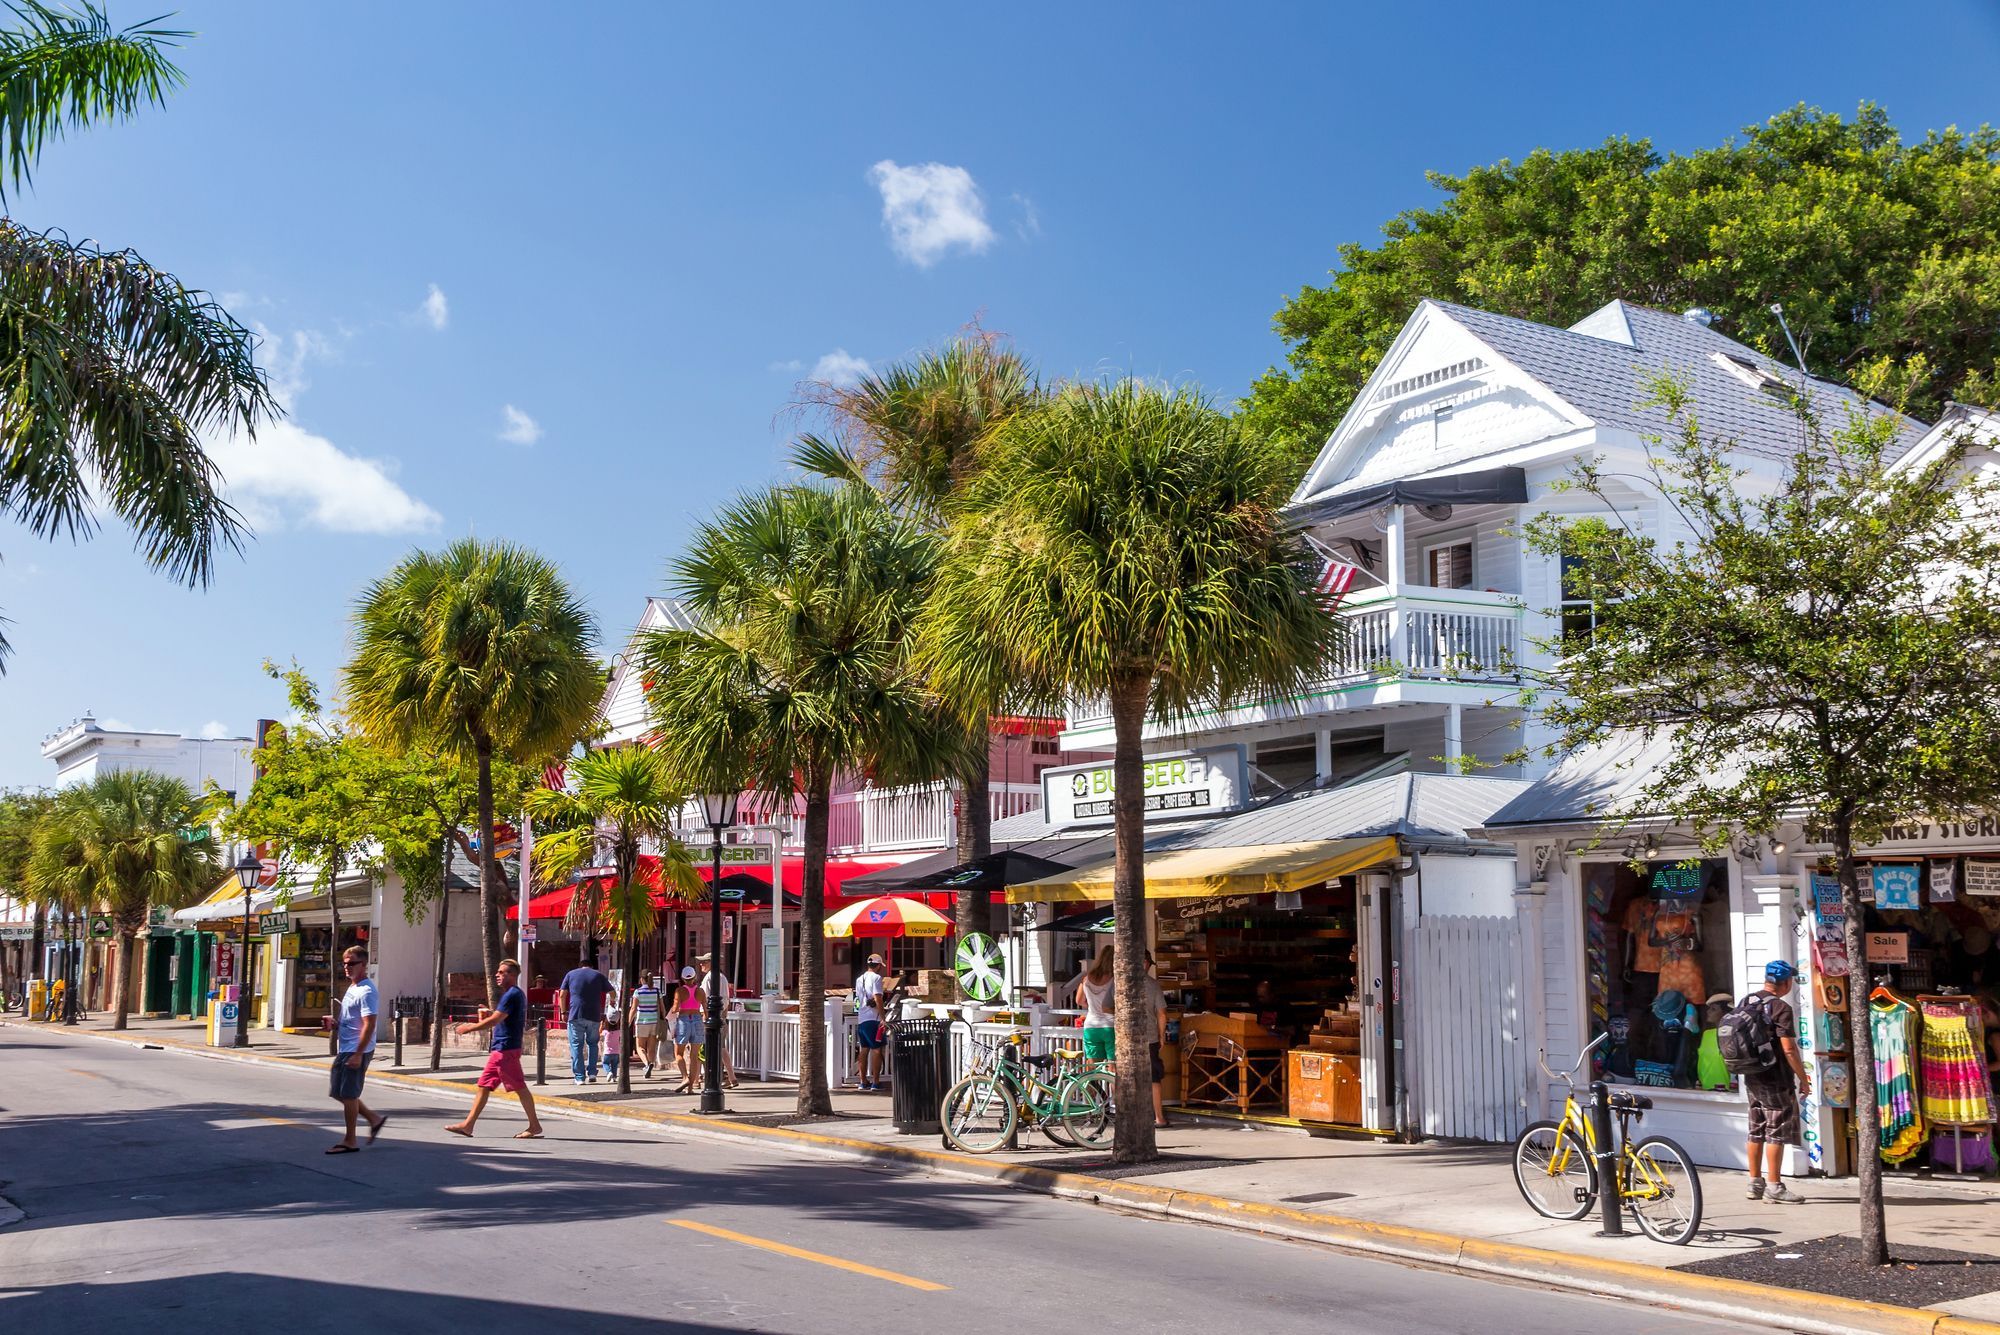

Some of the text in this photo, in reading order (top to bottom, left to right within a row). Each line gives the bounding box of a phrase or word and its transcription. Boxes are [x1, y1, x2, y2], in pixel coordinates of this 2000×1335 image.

[1092, 755, 1209, 794] BUGERFI
[687, 847, 769, 862] BUGERFI
[1652, 869, 1700, 888] ATM
[261, 913, 288, 927] ATM
[1873, 935, 1898, 945] Sale
